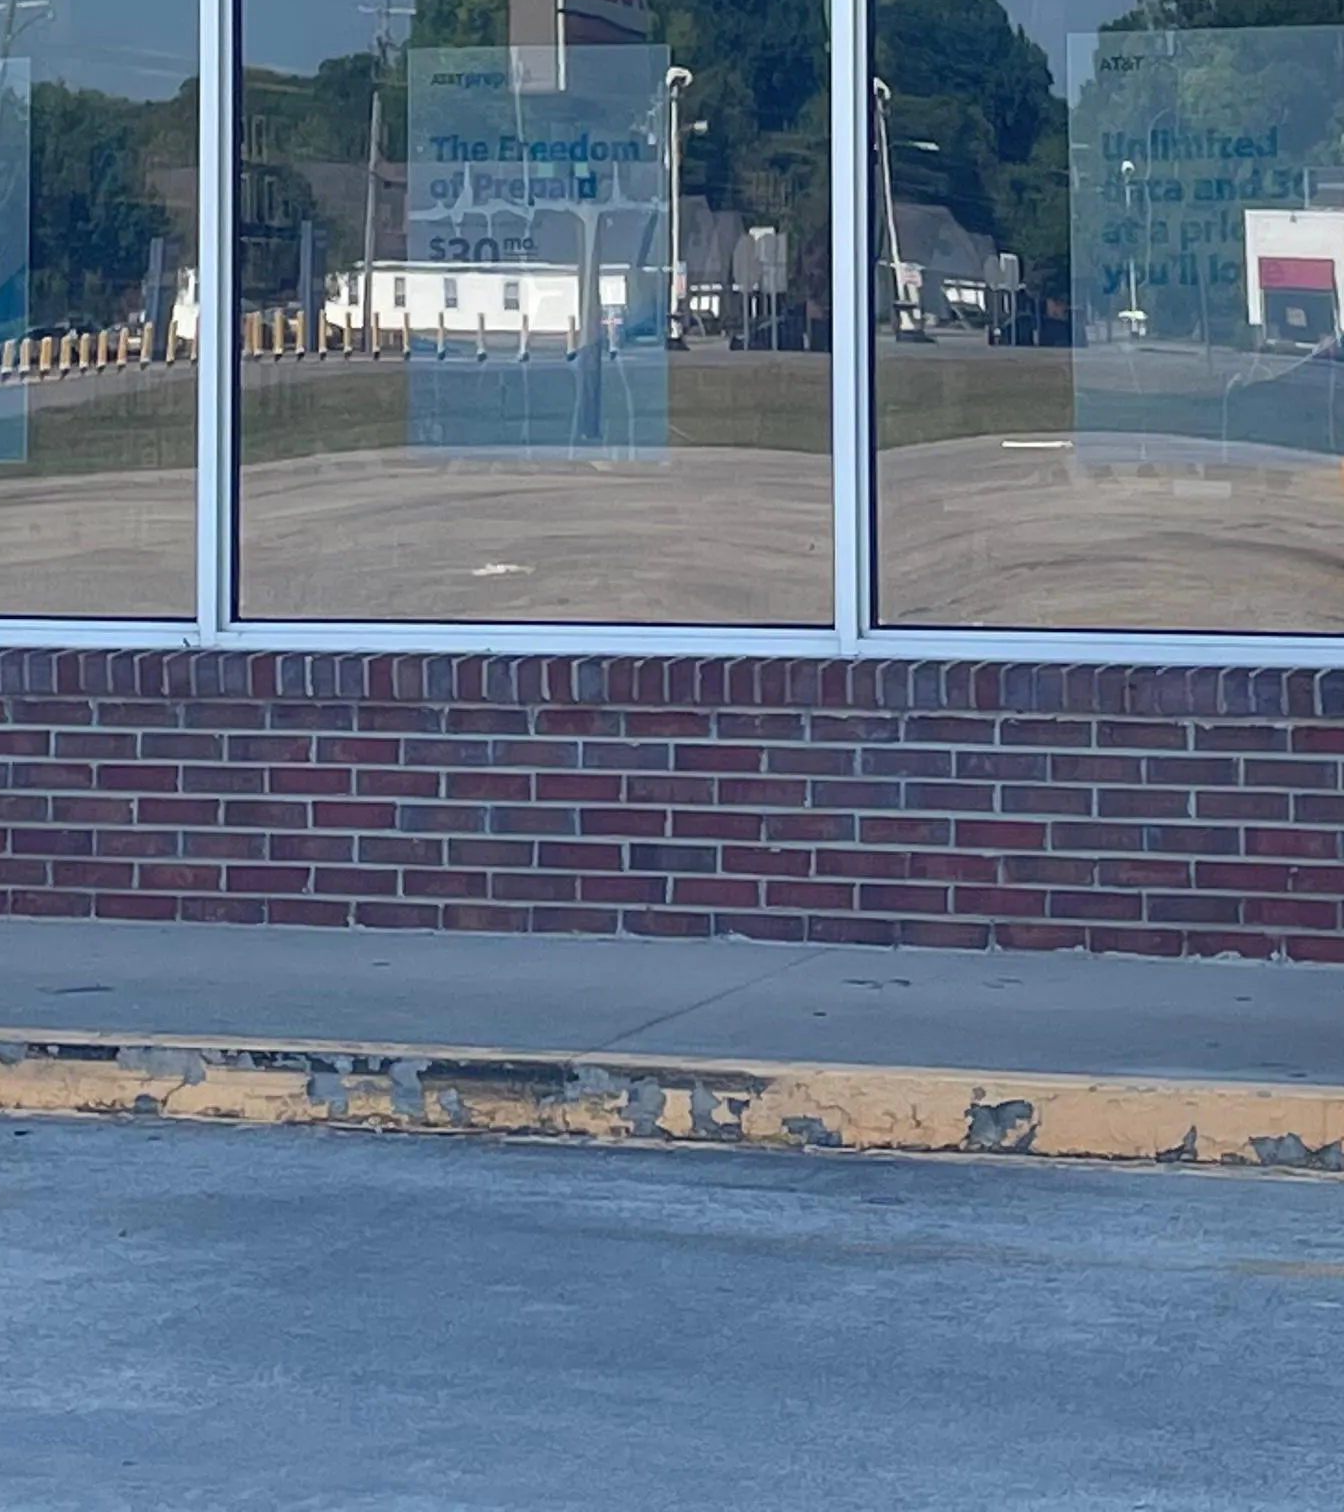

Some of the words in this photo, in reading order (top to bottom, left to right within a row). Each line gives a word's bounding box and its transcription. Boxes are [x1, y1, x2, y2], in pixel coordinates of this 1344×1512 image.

[1099, 55, 1144, 72] AT&T
[430, 134, 489, 162] The
[497, 133, 640, 162] Freedom
[1101, 125, 1278, 161] Unlimited
[430, 171, 465, 199] of
[472, 170, 598, 205] Prepaid
[1194, 167, 1260, 201] and
[1101, 216, 1141, 244] at
[1181, 209, 1270, 251] pric
[1101, 253, 1198, 294] you'll
[1209, 253, 1286, 286] loe
